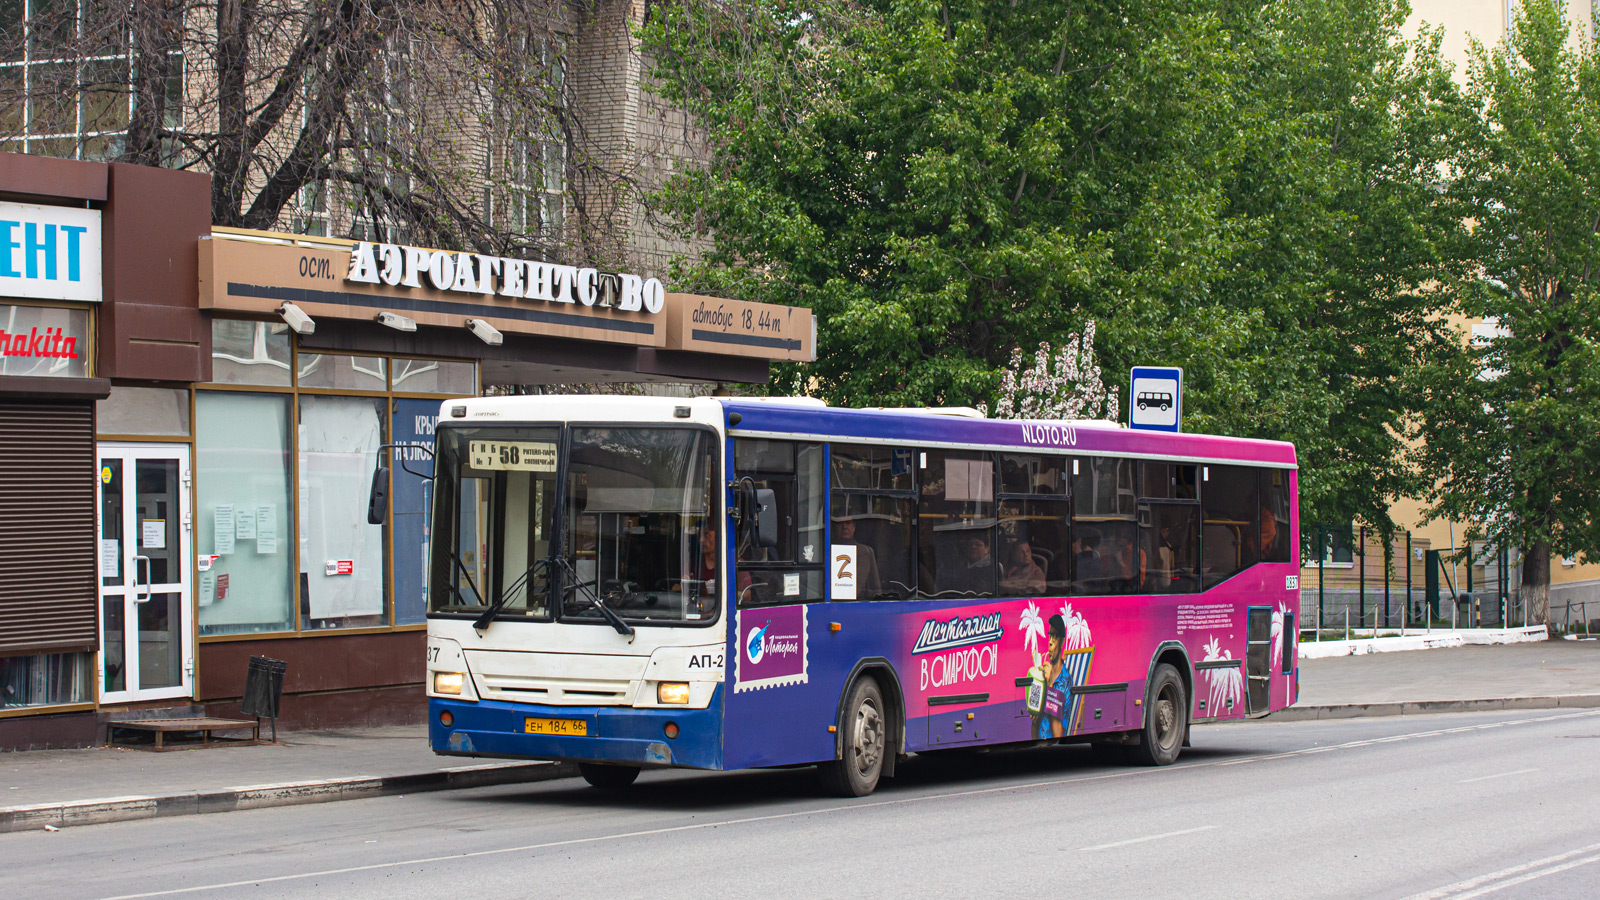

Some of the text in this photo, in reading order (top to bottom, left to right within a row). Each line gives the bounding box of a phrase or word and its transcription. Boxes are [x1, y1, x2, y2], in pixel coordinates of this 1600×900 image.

[300, 241, 665, 314] ост. АЭРОАГЕНТСТВО
[692, 300, 733, 331] автобус
[741, 308, 755, 332] 18,
[1021, 424, 1077, 446] NLOTO.RU
[499, 445, 520, 465] 58
[765, 634, 799, 658] Лотерея
[912, 611, 1002, 653] Мечталлион
[920, 643, 998, 692] В СМАРТФОН
[548, 720, 567, 733] 184
[572, 720, 584, 731] 66
